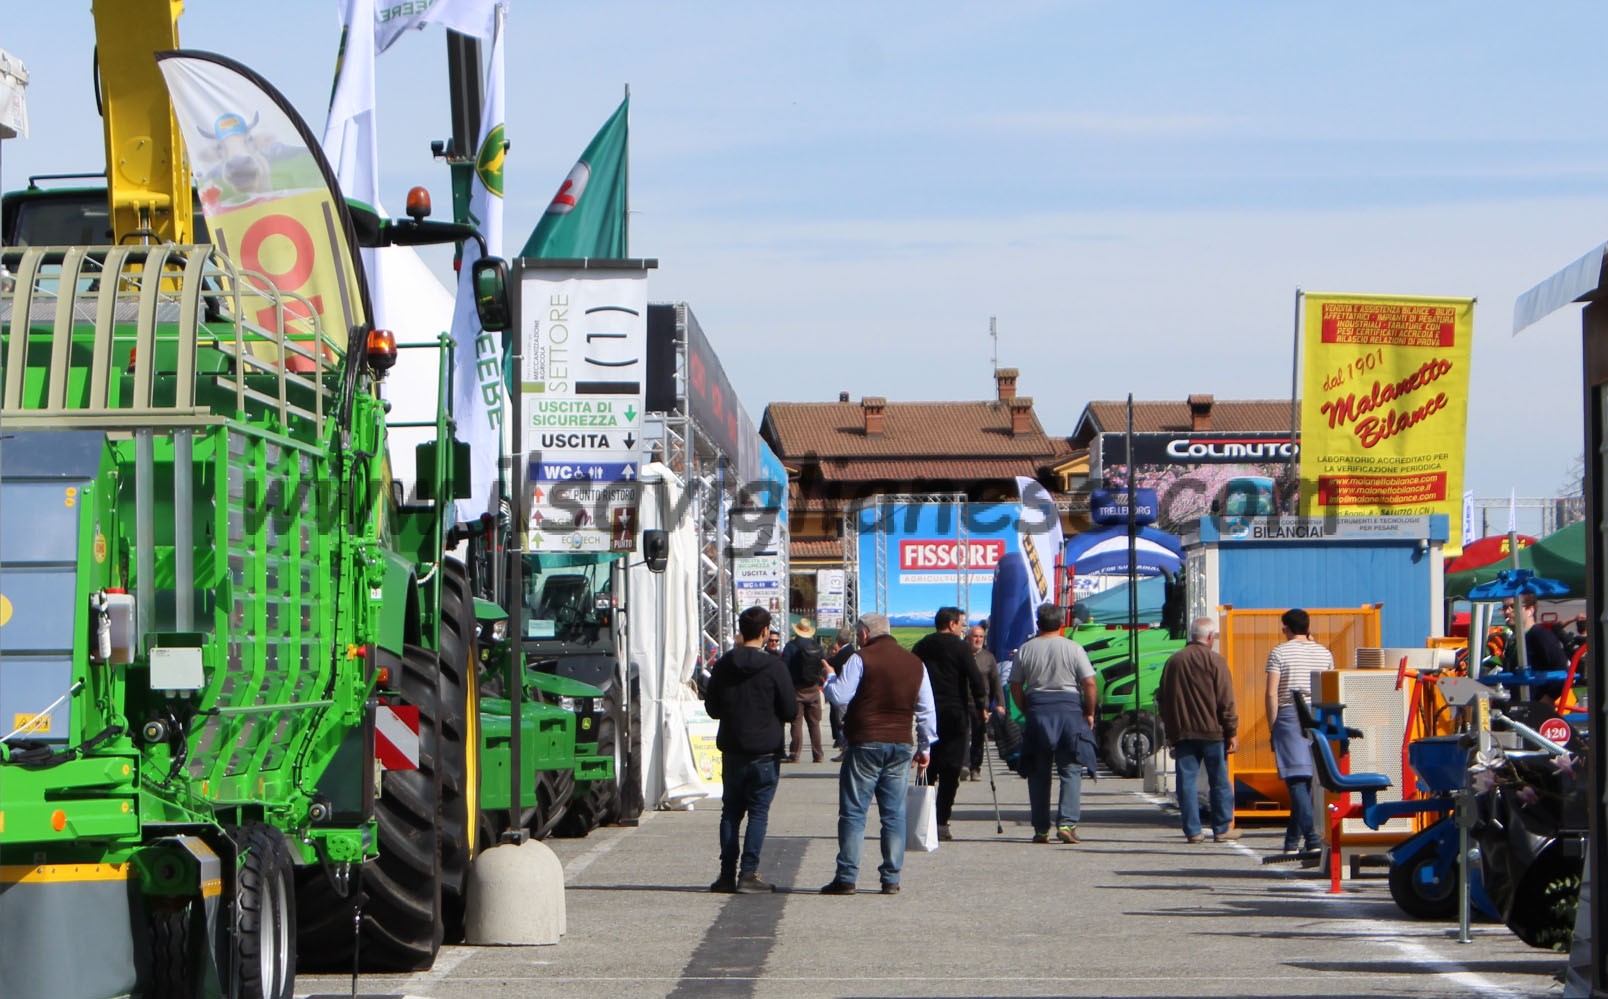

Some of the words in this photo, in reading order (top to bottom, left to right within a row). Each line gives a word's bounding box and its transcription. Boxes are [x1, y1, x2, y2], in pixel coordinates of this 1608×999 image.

[1360, 305, 1400, 313] ASSISTENZA
[1402, 306, 1429, 314] BILANCE
[1337, 320, 1382, 328] INDUSTRIALI
[1388, 322, 1423, 330] TARATURE
[1418, 315, 1454, 323] PESATURA
[549, 294, 569, 392] SETTORE
[1323, 367, 1345, 392] dal
[1347, 348, 1383, 380] 1901
[1321, 358, 1453, 429] Malanetto
[539, 401, 592, 413] USCITA
[597, 401, 612, 413] DI
[533, 414, 618, 426] SICUREZZA
[1354, 392, 1449, 449] Bilance
[541, 433, 610, 448] USCITA
[1317, 455, 1375, 464] LABORATORIO
[1377, 455, 1431, 464] ACCREDITATO
[1433, 453, 1449, 461] PER
[544, 465, 572, 479] WC
[1324, 465, 1334, 473] LA
[1337, 466, 1398, 474] VERIFICAZIONE
[1400, 463, 1441, 473] PERIODICA
[574, 489, 600, 501] PUNTO
[602, 489, 635, 501] RISTORO
[1253, 526, 1323, 539] BILANCIAI
[905, 544, 999, 566] FISSORE
[1543, 728, 1567, 740] 420
